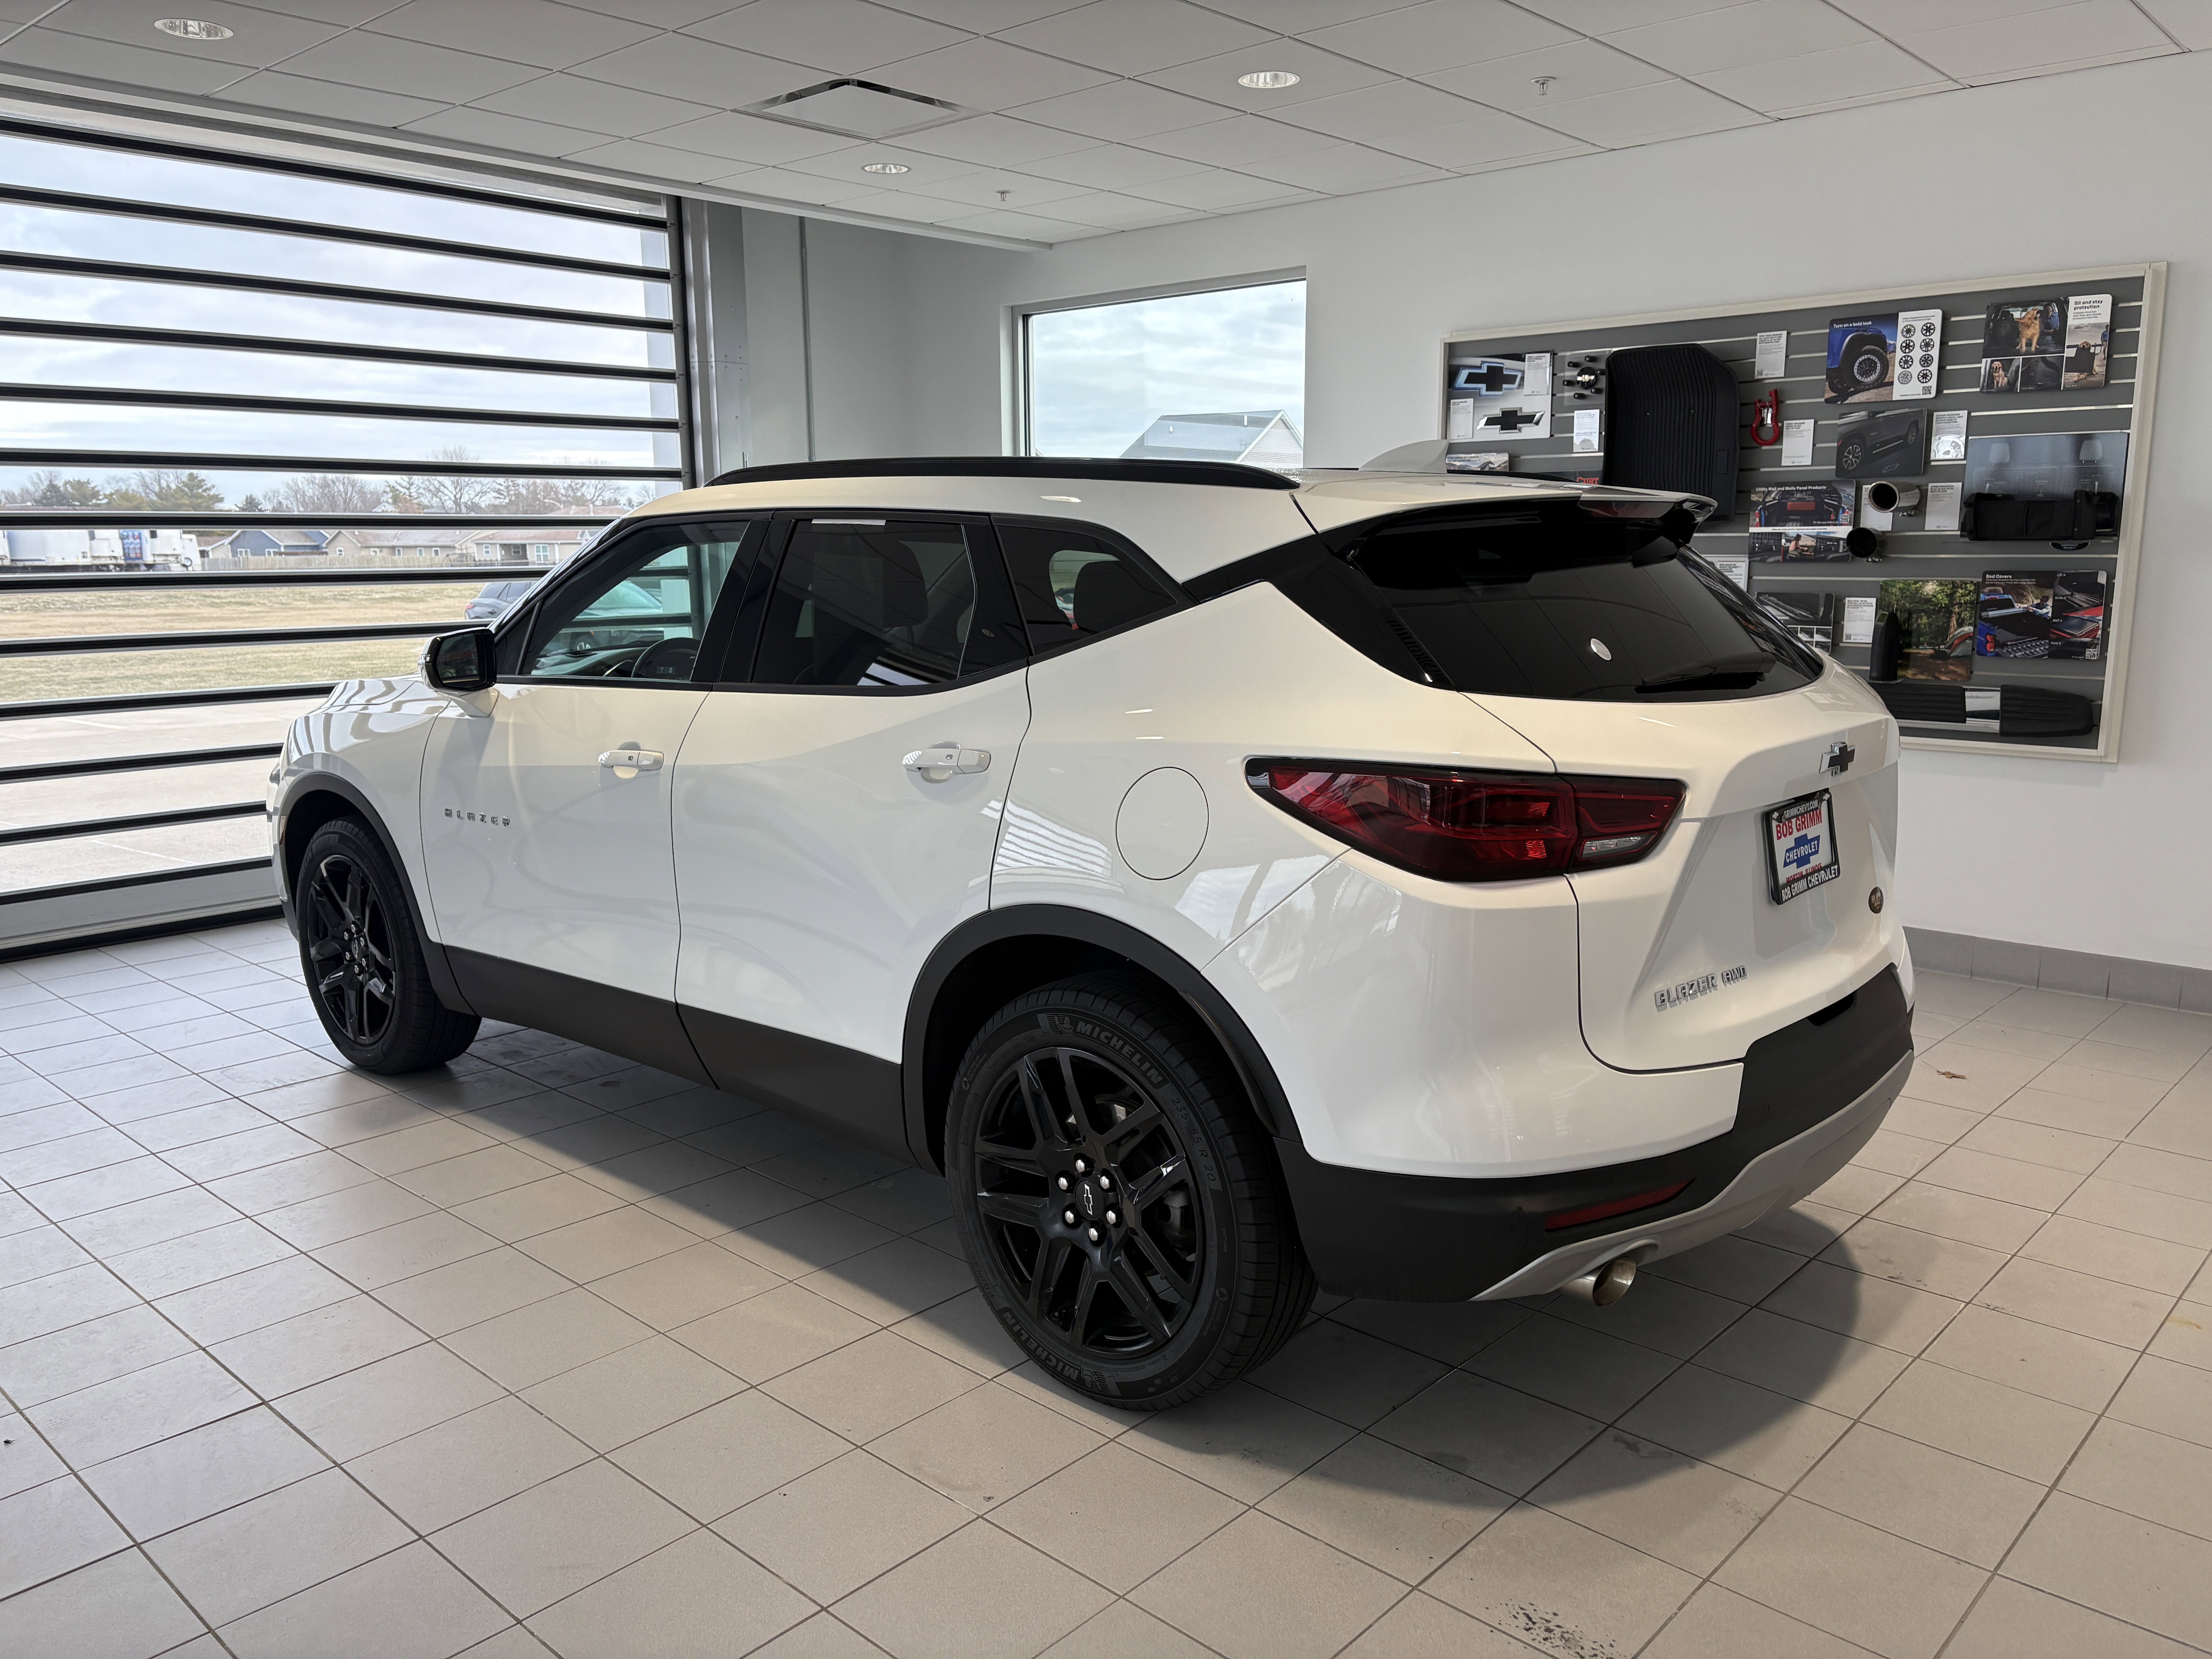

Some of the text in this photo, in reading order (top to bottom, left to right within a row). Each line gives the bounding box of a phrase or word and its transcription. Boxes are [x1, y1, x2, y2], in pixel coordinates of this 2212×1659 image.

[1577, 477, 1599, 485] CURT
[445, 808, 510, 827] BLAZER
[1776, 809, 1822, 840] BOB GRIMM
[1783, 799, 1818, 819] GRIMMCHEVY.COM
[1786, 840, 1818, 863] CHEVROLET
[1782, 865, 1838, 902] BOB GRIMM CHEVROLET
[1654, 965, 1747, 1007] BLAZER AWD
[1076, 1021, 1163, 1084] MICHELIN
[1171, 1097, 1216, 1182] 235/55 R 20
[967, 1243, 995, 1297] PRIMACY
[1003, 1312, 1080, 1381] MICHELIN
